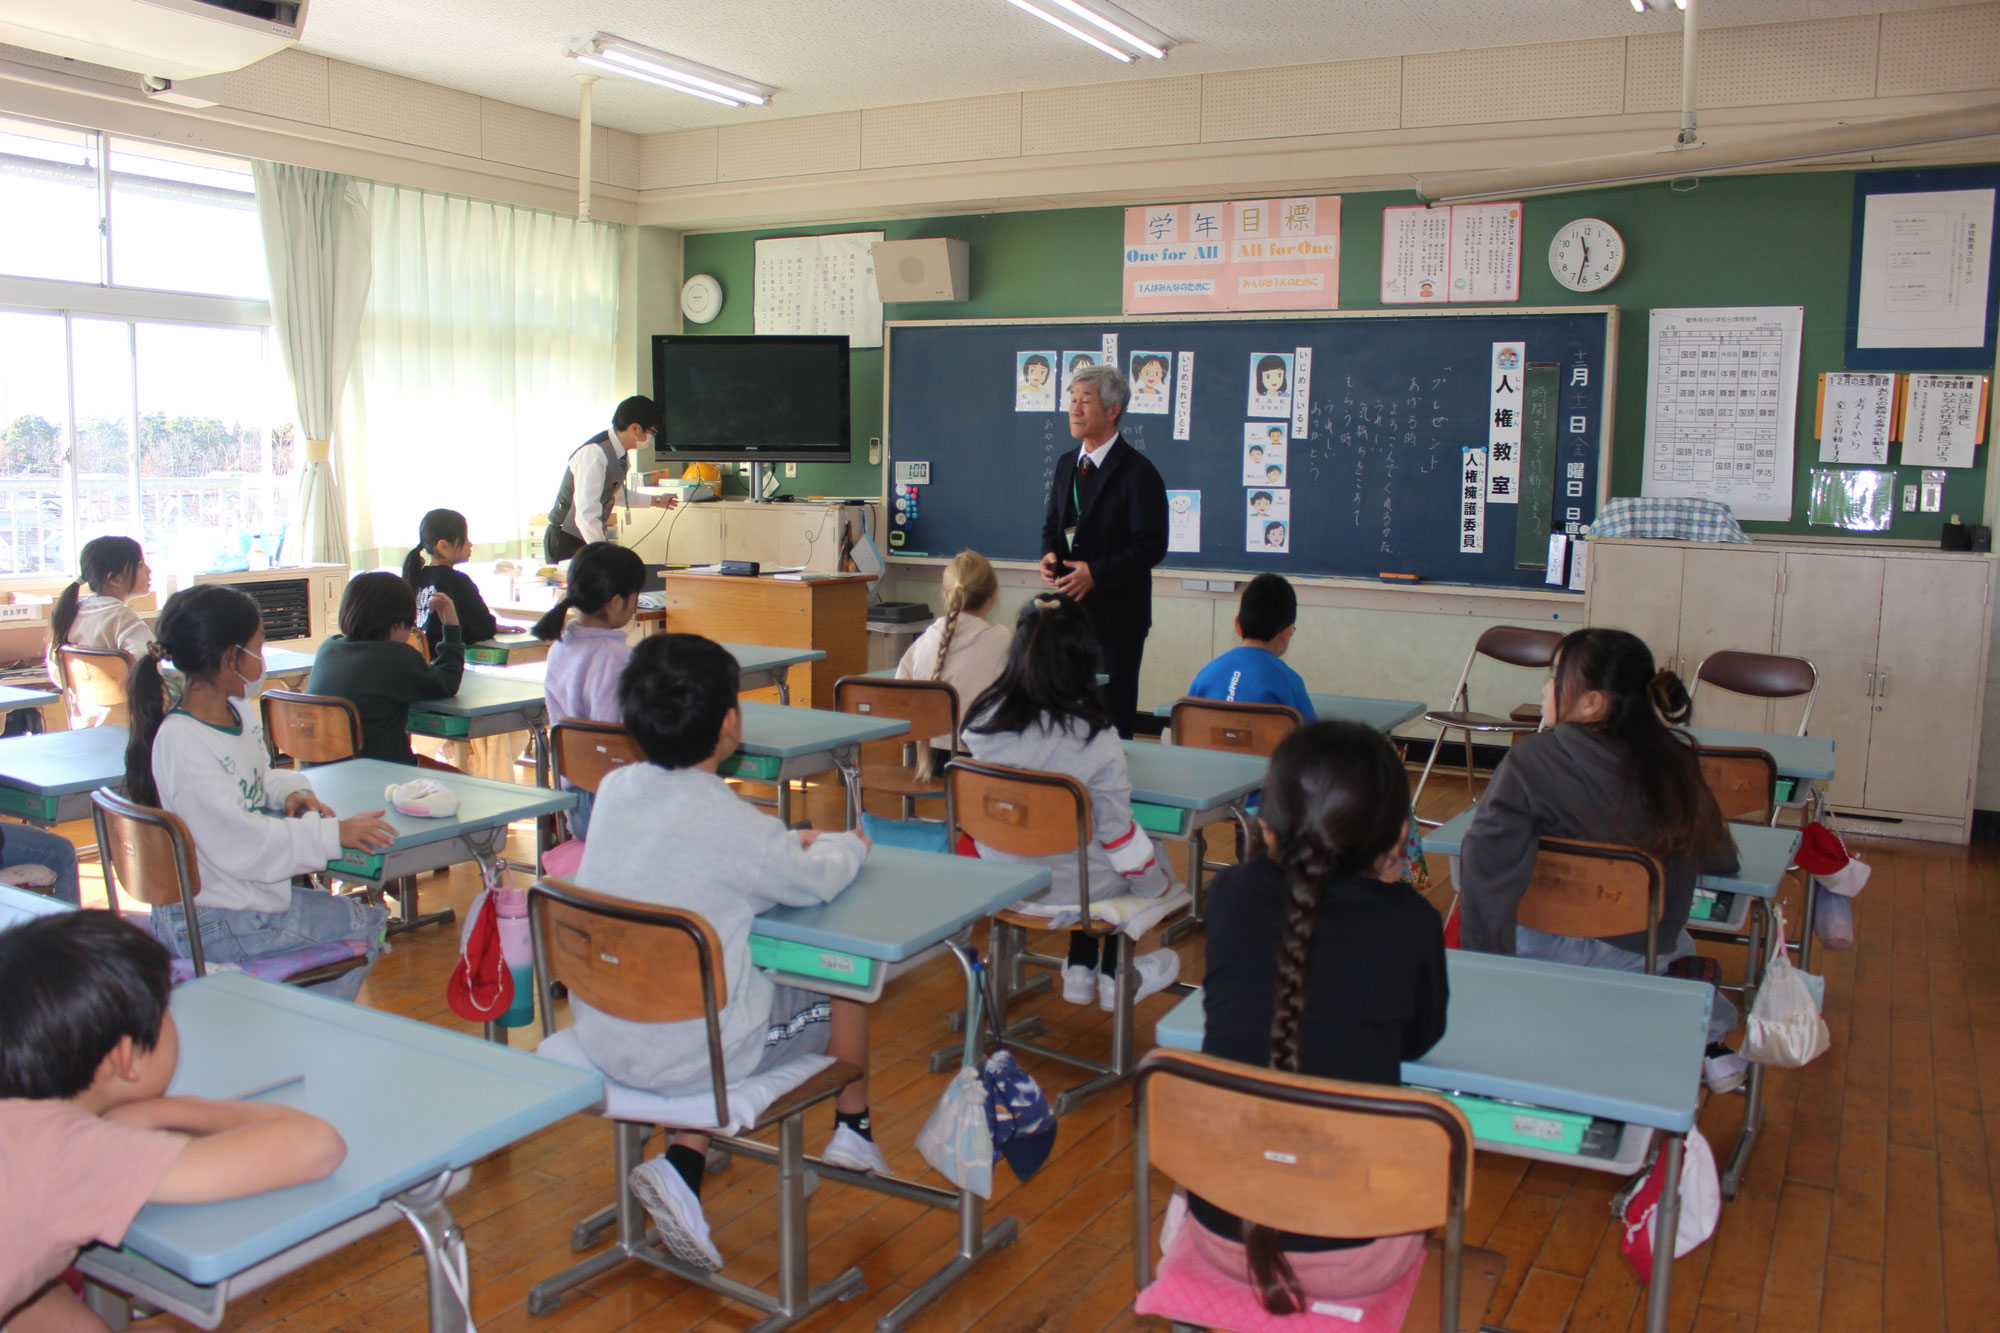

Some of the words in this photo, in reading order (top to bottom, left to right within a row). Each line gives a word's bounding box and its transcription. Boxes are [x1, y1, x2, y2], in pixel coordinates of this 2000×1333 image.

[1150, 204, 1310, 240] 学年目標
[1584, 228, 1591, 236] 12
[1562, 240, 1570, 248] 10
[1606, 239, 1611, 247] 2
[1238, 244, 1262, 258] All
[1270, 242, 1294, 256] for
[1298, 240, 1332, 255] One
[1127, 250, 1158, 262] One
[1162, 248, 1186, 261] for
[1194, 246, 1218, 259] All
[1559, 252, 1564, 260] 9
[1609, 252, 1614, 260] 3
[1562, 264, 1568, 272] 8
[1595, 272, 1600, 280] 5
[1106, 336, 1114, 367] いじめ
[1681, 351, 1697, 359] 国語
[1701, 351, 1717, 359] 算数
[1742, 351, 1758, 359] 算数
[1680, 370, 1696, 378] 算数
[1700, 370, 1716, 378] 理科
[1720, 370, 1737, 378] 体育
[1741, 370, 1757, 378] 理科
[1761, 370, 1778, 378] 理科
[1177, 355, 1190, 436] いじめられている子
[1296, 351, 1308, 436] いじめている子
[1720, 390, 1736, 398] 算数
[1760, 390, 1777, 398] 体育
[1340, 376, 1352, 447] もらう時
[1404, 377, 1422, 446] あげる時
[1698, 409, 1714, 417] 国語
[1718, 409, 1734, 417] 図工
[1739, 409, 1754, 417] 国語
[1759, 409, 1776, 417] 算数
[1491, 374, 1514, 495] 人権教室
[1737, 443, 1753, 451] 国語
[1676, 448, 1692, 456] 国語
[1757, 450, 1773, 458] 国語
[1353, 402, 1370, 526] 気持ちをこめて
[1715, 462, 1731, 470] 国語
[1756, 469, 1772, 477] 学活
[1463, 453, 1478, 549] 人権擁護委員
[3, 608, 28, 616] 自主学習
